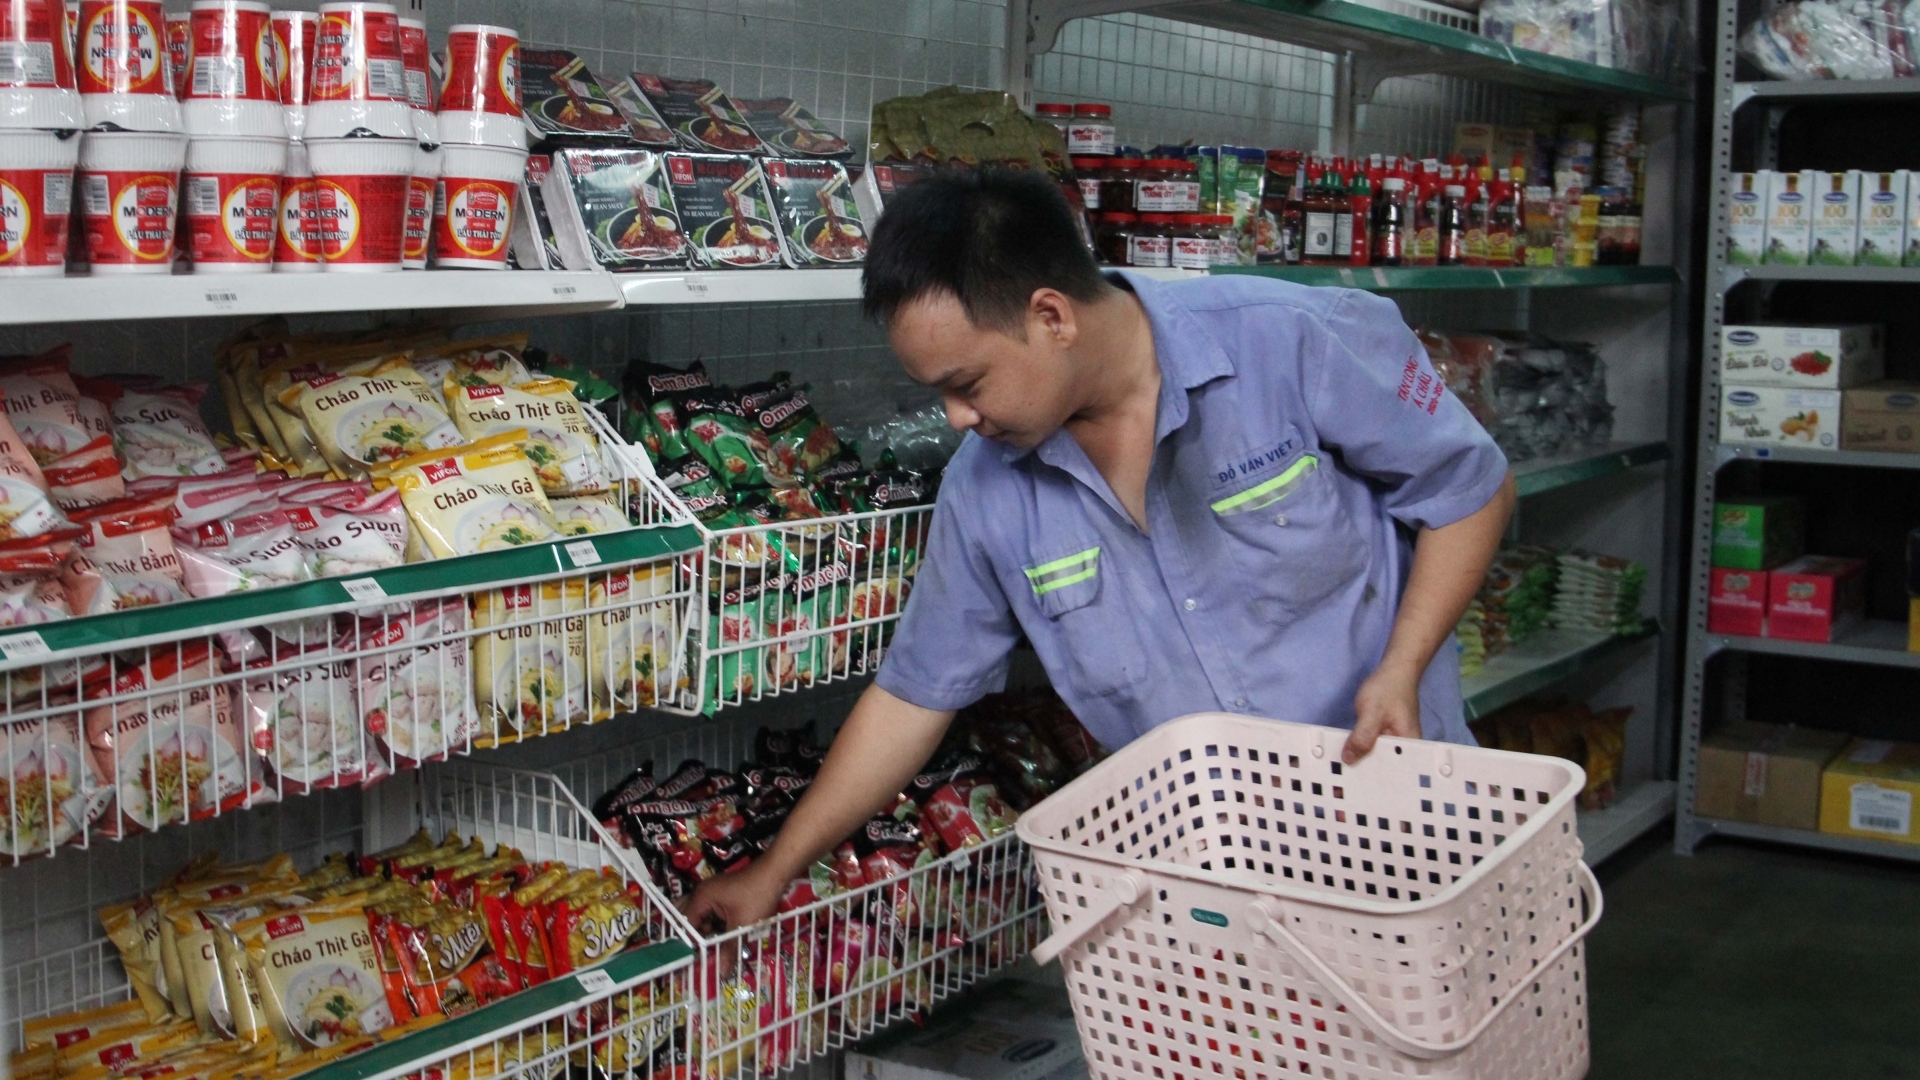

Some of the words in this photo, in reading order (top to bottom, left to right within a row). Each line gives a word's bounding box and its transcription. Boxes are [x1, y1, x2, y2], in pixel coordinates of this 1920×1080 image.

[674, 173, 692, 181] VIFON
[455, 207, 504, 221] MODERN
[1403, 355, 1418, 383] LONG
[315, 390, 360, 412] Cháo
[360, 379, 398, 394] Thịt
[470, 387, 501, 397] VIFON
[469, 408, 511, 423] Cháo
[515, 402, 551, 421] Thịt
[555, 401, 577, 415] Gà
[430, 467, 458, 481] VIFON
[433, 487, 478, 510] Cháo
[477, 482, 511, 496] Thịt
[511, 477, 535, 496] Gà
[569, 646, 581, 656] 70
[271, 945, 312, 969] Cháo
[316, 936, 349, 957] Thịt
[351, 929, 371, 948] Gà
